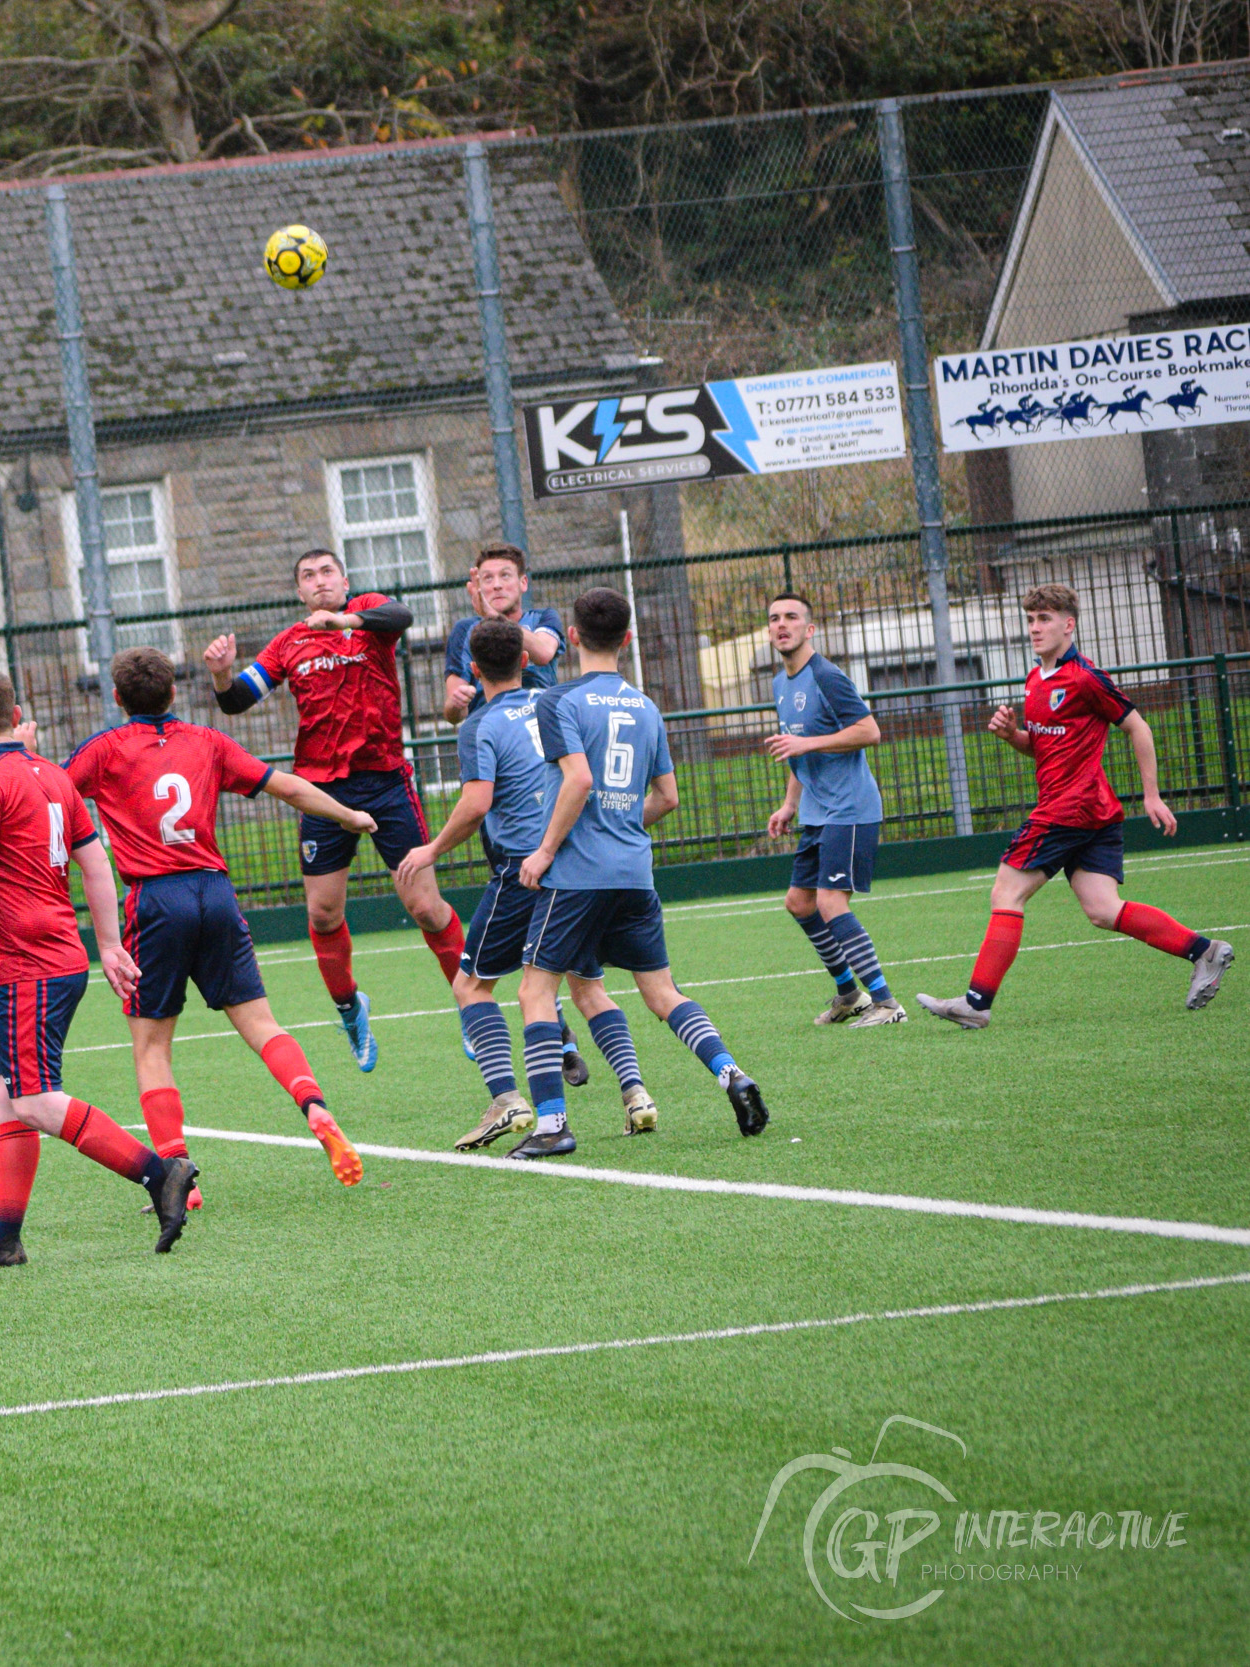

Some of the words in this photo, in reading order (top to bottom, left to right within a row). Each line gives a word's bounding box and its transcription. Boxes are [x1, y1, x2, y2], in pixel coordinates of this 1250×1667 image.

[942, 349, 1059, 383] MARTIN
[1069, 337, 1173, 370] DAVIES
[1183, 328, 1250, 357] RAC
[745, 377, 803, 393] DOMESTIC
[806, 376, 815, 386] &
[817, 367, 893, 385] COMMERCIAL
[990, 374, 1070, 396] Rhondda's
[1075, 368, 1163, 387] On-Course
[1168, 356, 1250, 376] Bookmake
[756, 401, 772, 415] T:
[776, 395, 821, 413] 07771
[825, 390, 859, 407] 584
[864, 385, 895, 402] 533
[538, 389, 706, 471] KES
[769, 404, 897, 427] keselectrical7@gmail.com
[551, 468, 634, 488] ELECTRICAL
[639, 460, 706, 477] SERVICES
[504, 702, 536, 721] Ever
[585, 693, 646, 709] Everest
[604, 711, 636, 788] 6
[153, 772, 196, 846] 2
[601, 800, 631, 811] SYSTEMS
[609, 791, 639, 803] WINDOW
[48, 802, 69, 876] 4
